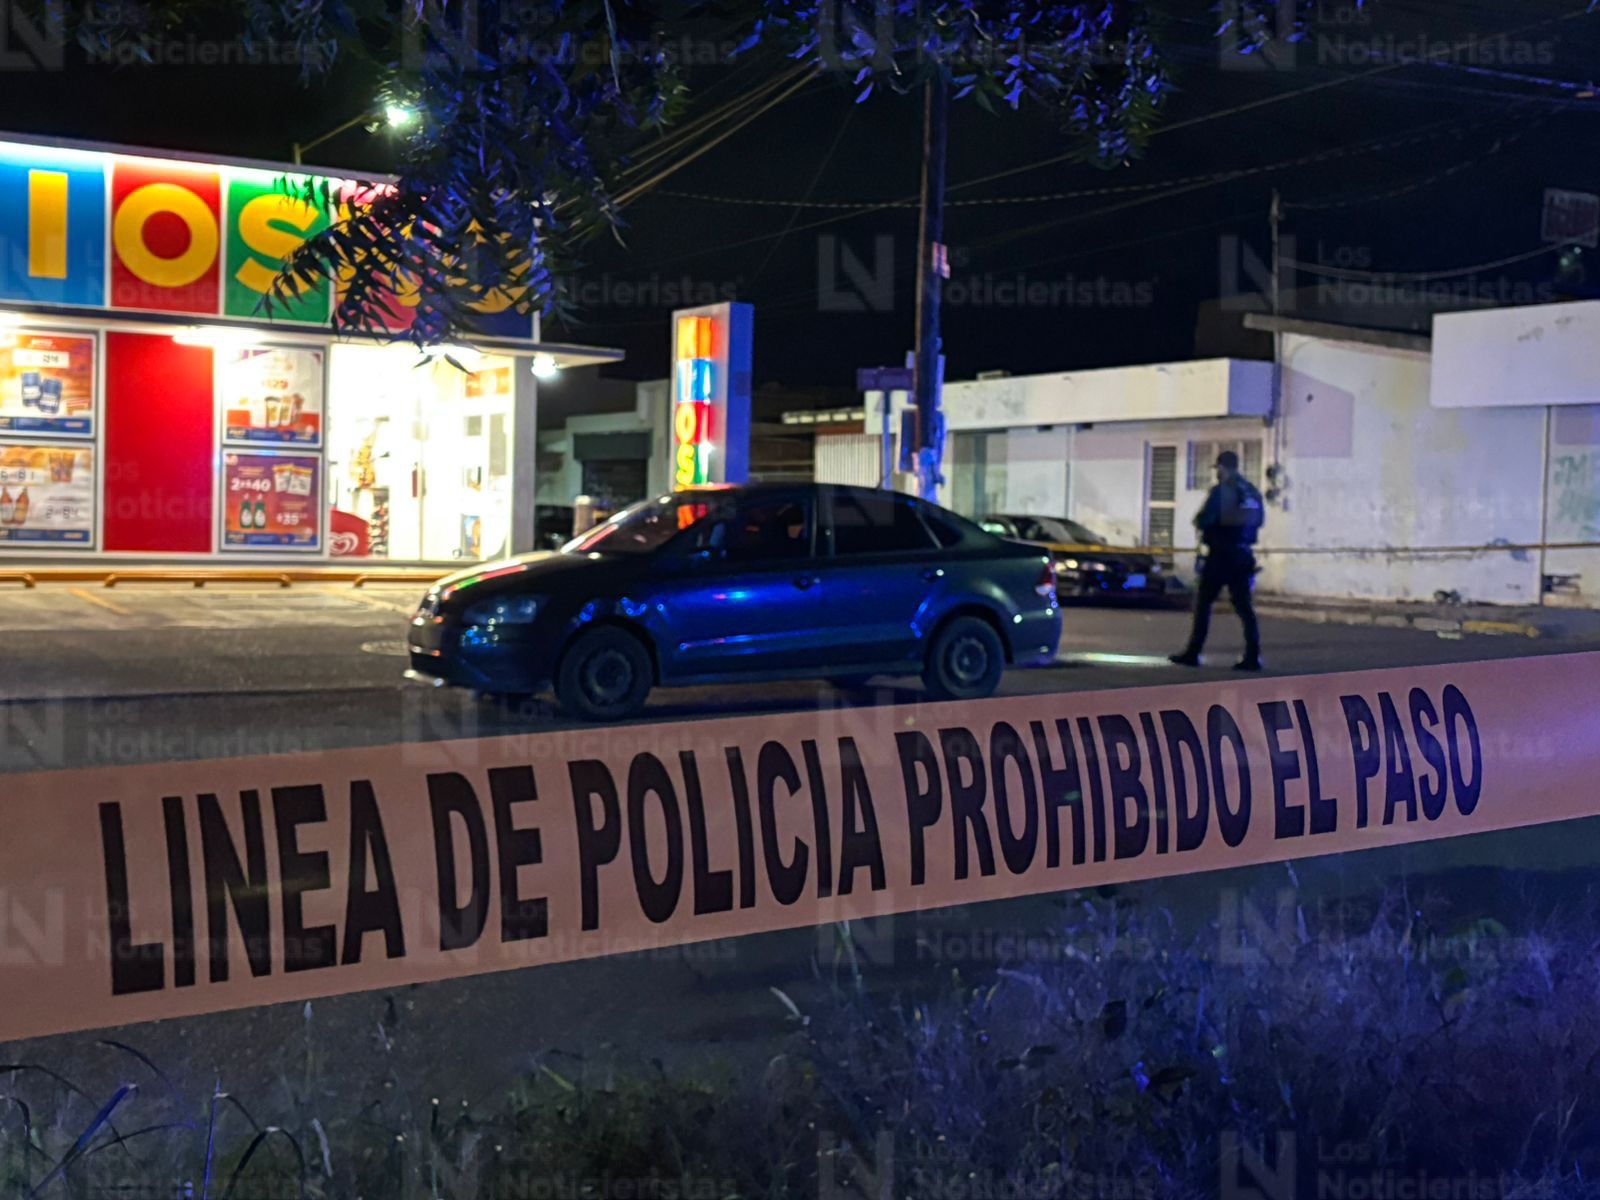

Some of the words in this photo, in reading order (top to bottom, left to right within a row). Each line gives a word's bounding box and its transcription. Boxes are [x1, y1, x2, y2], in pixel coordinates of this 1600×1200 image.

[99, 779, 405, 995] LINEA
[426, 764, 549, 953] DE
[568, 735, 886, 931] POLICIA
[893, 703, 1252, 886] PROHIBIDO
[1257, 699, 1338, 840] EL
[1340, 683, 1482, 829] PASO
